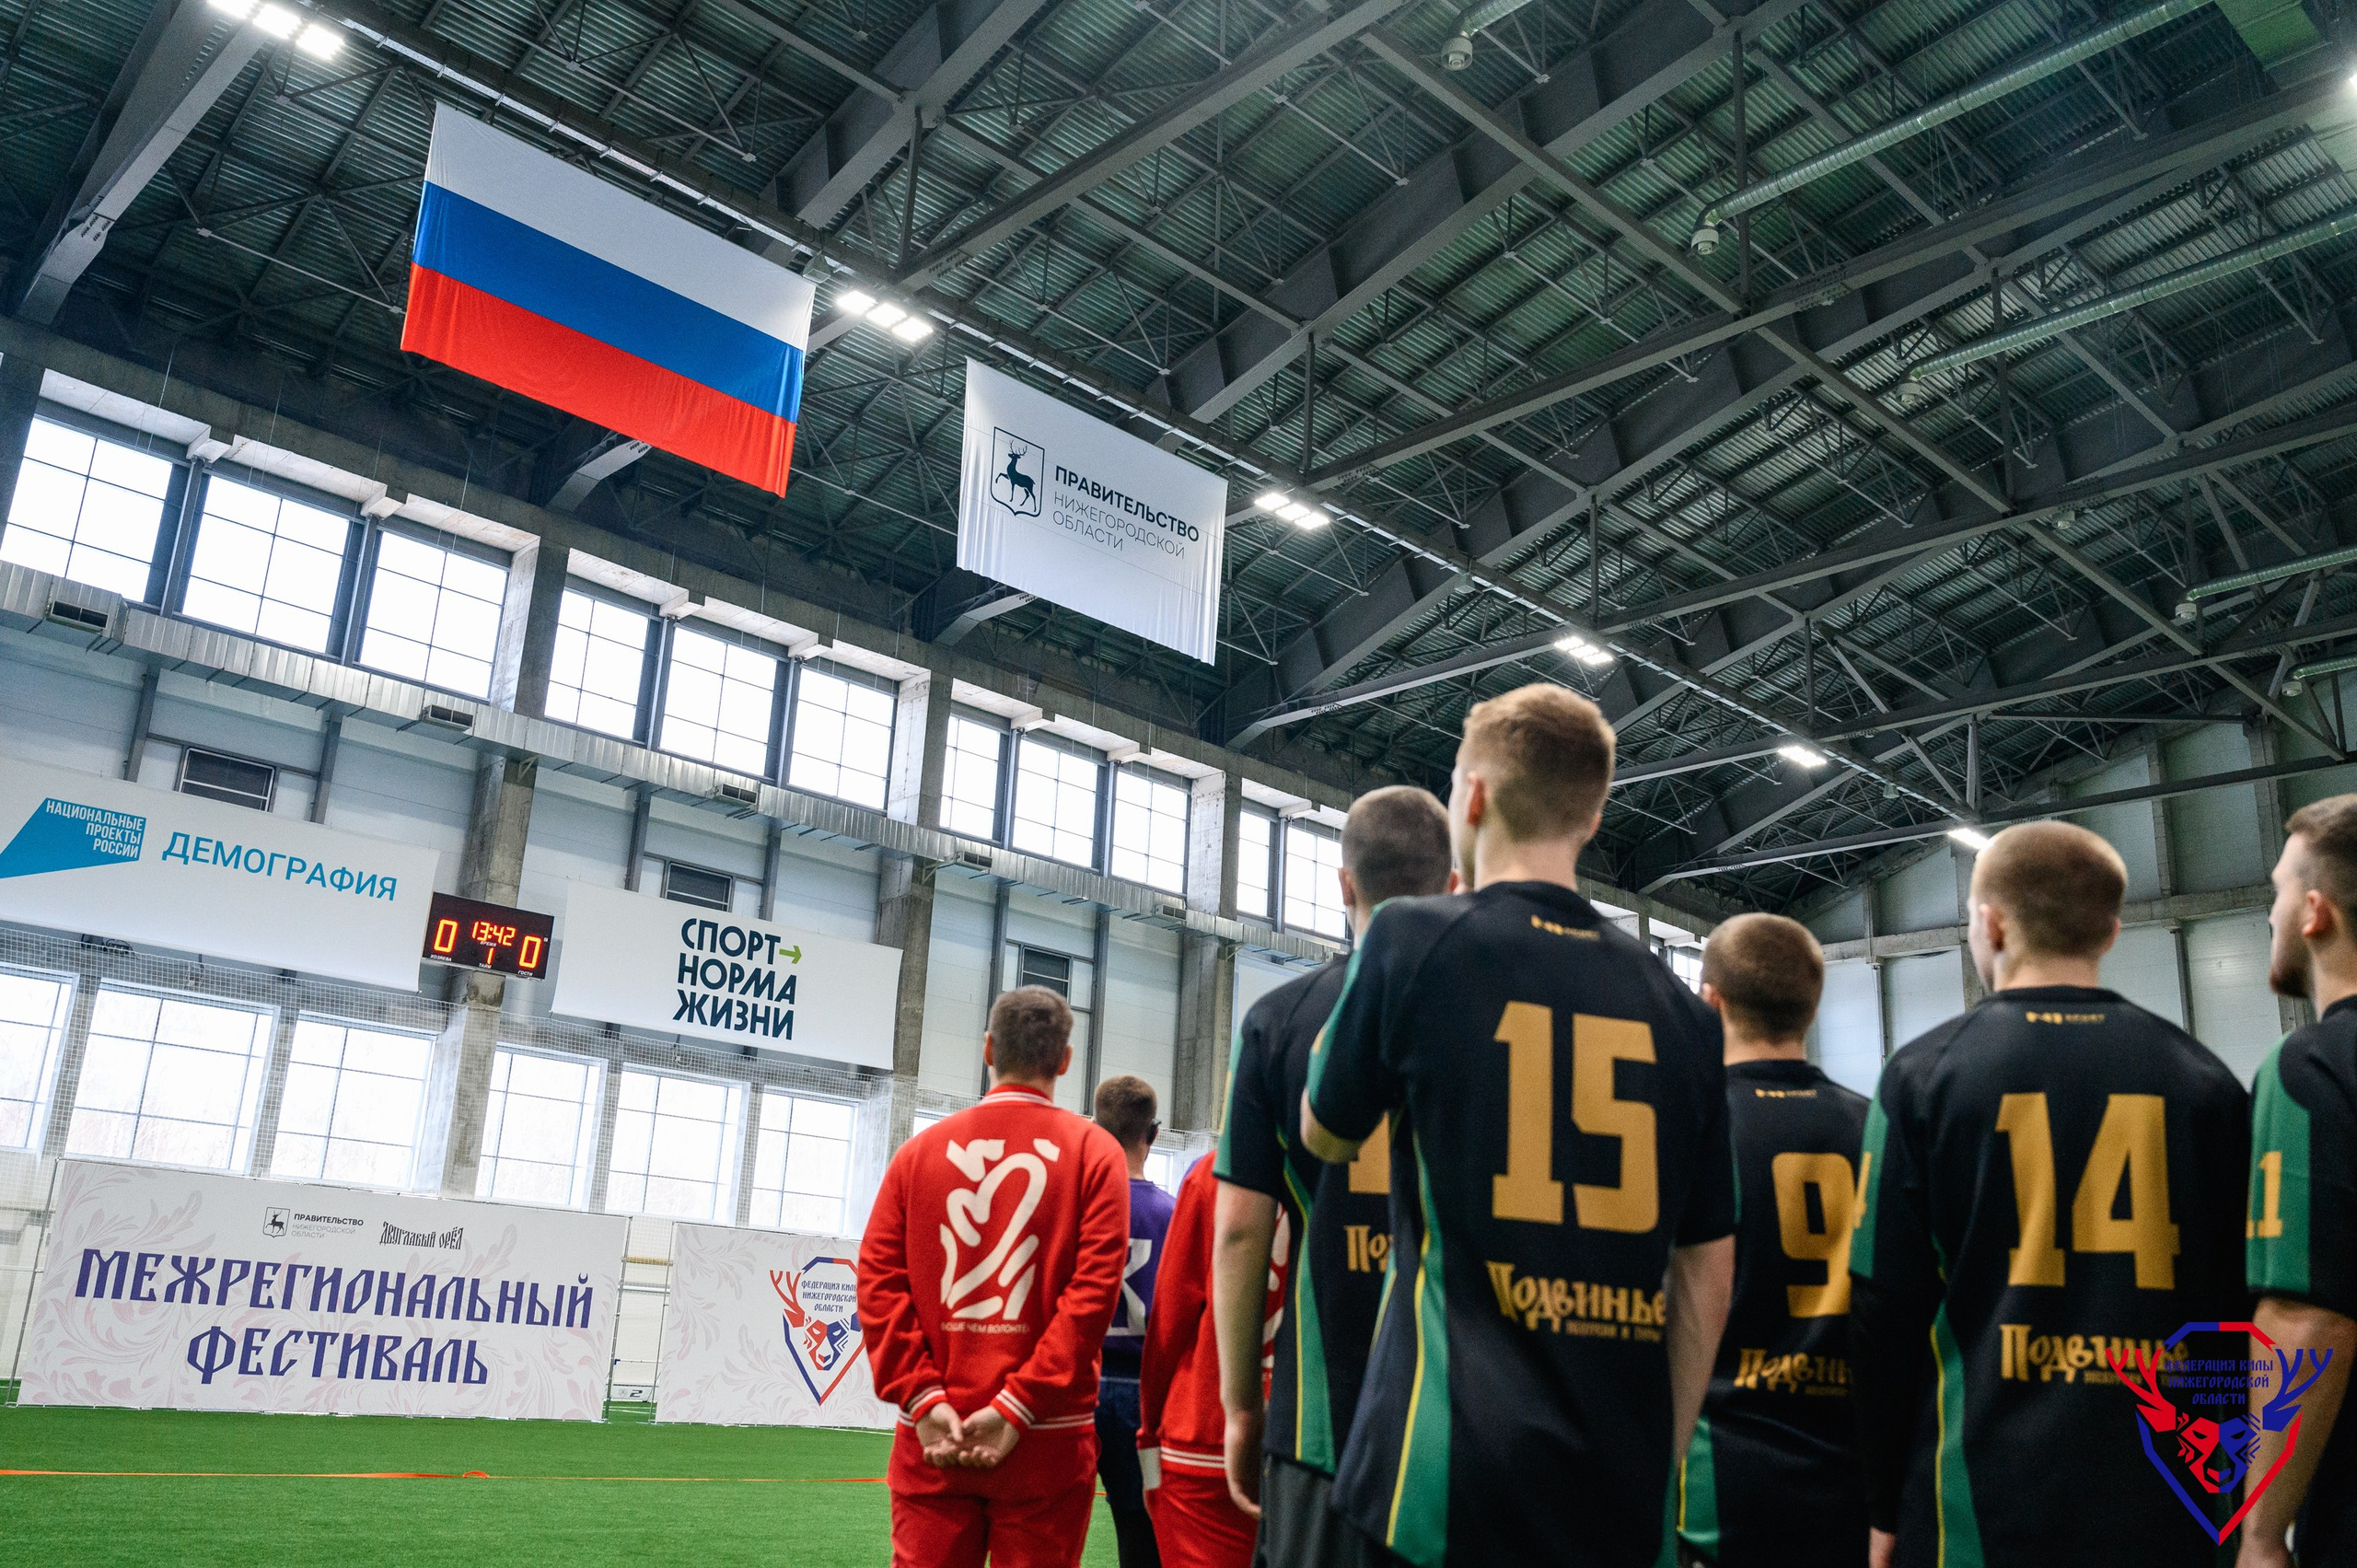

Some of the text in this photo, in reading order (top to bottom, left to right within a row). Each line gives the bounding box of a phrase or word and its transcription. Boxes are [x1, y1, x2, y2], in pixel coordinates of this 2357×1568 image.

[1055, 465, 1200, 542] ПРАВИТЕЛЬСТВО
[1052, 510, 1123, 552] ОБЛАСТИ
[1054, 491, 1185, 560] НИЖЕГОРОДСКОЙ
[46, 799, 144, 831] НАЦИОНАЛЬНЫЕ
[86, 822, 141, 844] ПРОЕКТЫ
[93, 838, 138, 858] РОССИИ
[161, 831, 398, 901] ДЕМОГРАФИЯ
[434, 919, 459, 953] 0
[471, 921, 516, 947] 13:42
[680, 917, 781, 966] СПОРТ
[430, 954, 452, 962] ХОЗЯЕВА
[486, 947, 494, 965] 1
[518, 935, 541, 969] 0
[677, 953, 797, 1005] НОРМА
[672, 989, 795, 1041] ЖИЗНИ
[1492, 1000, 1658, 1234] 15
[1995, 1092, 2181, 1289] 14
[291, 1230, 325, 1238] ОБЛАСТИ
[292, 1223, 355, 1235] НИЖЕГОРОДСКОЙ
[294, 1213, 364, 1226] ПРАВИТЕЛЬСТВО
[1771, 1152, 1854, 1318] 9
[75, 1247, 594, 1329] МЕЖРЕГИОНАЛЬНЫЙ
[801, 1280, 841, 1291] ФЕДЕРАЦИЯ
[814, 1304, 843, 1313] ОБЛАСТИ
[186, 1325, 488, 1385] ФЕСТИВАЛЬ
[630, 1389, 643, 1398] 2
